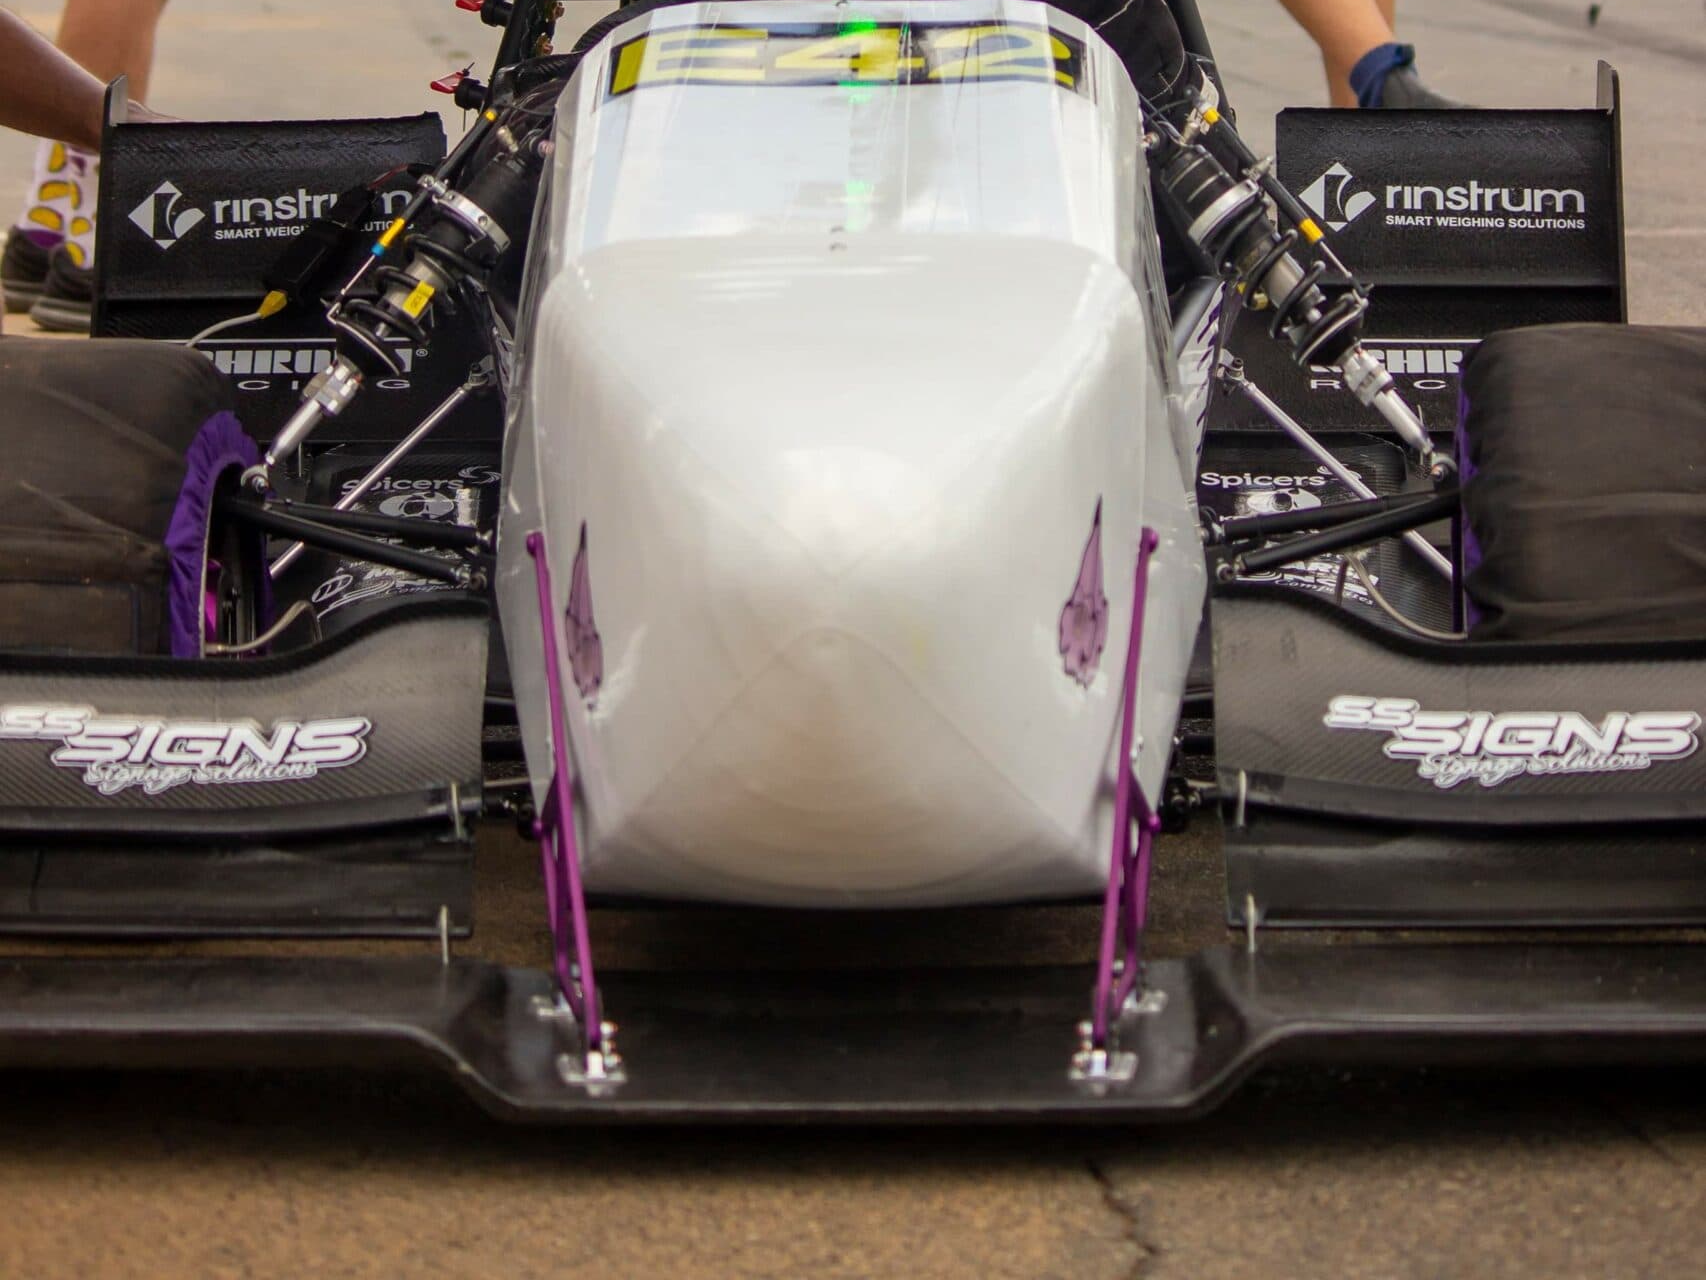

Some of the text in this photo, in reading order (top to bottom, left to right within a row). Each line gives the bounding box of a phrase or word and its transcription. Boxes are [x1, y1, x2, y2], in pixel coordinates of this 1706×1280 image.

[611, 23, 1075, 95] E42
[1386, 181, 1585, 213] rinstrum
[215, 228, 262, 240] SMART
[1386, 215, 1585, 230] SMART WEIGHING SOLUTIONS
[1201, 472, 1326, 489] Spicers
[0, 707, 369, 765] SS SIGNS
[1326, 697, 1699, 757] SS SIGNS
[194, 752, 316, 783] Solutions
[1529, 745, 1650, 773] Solutions
